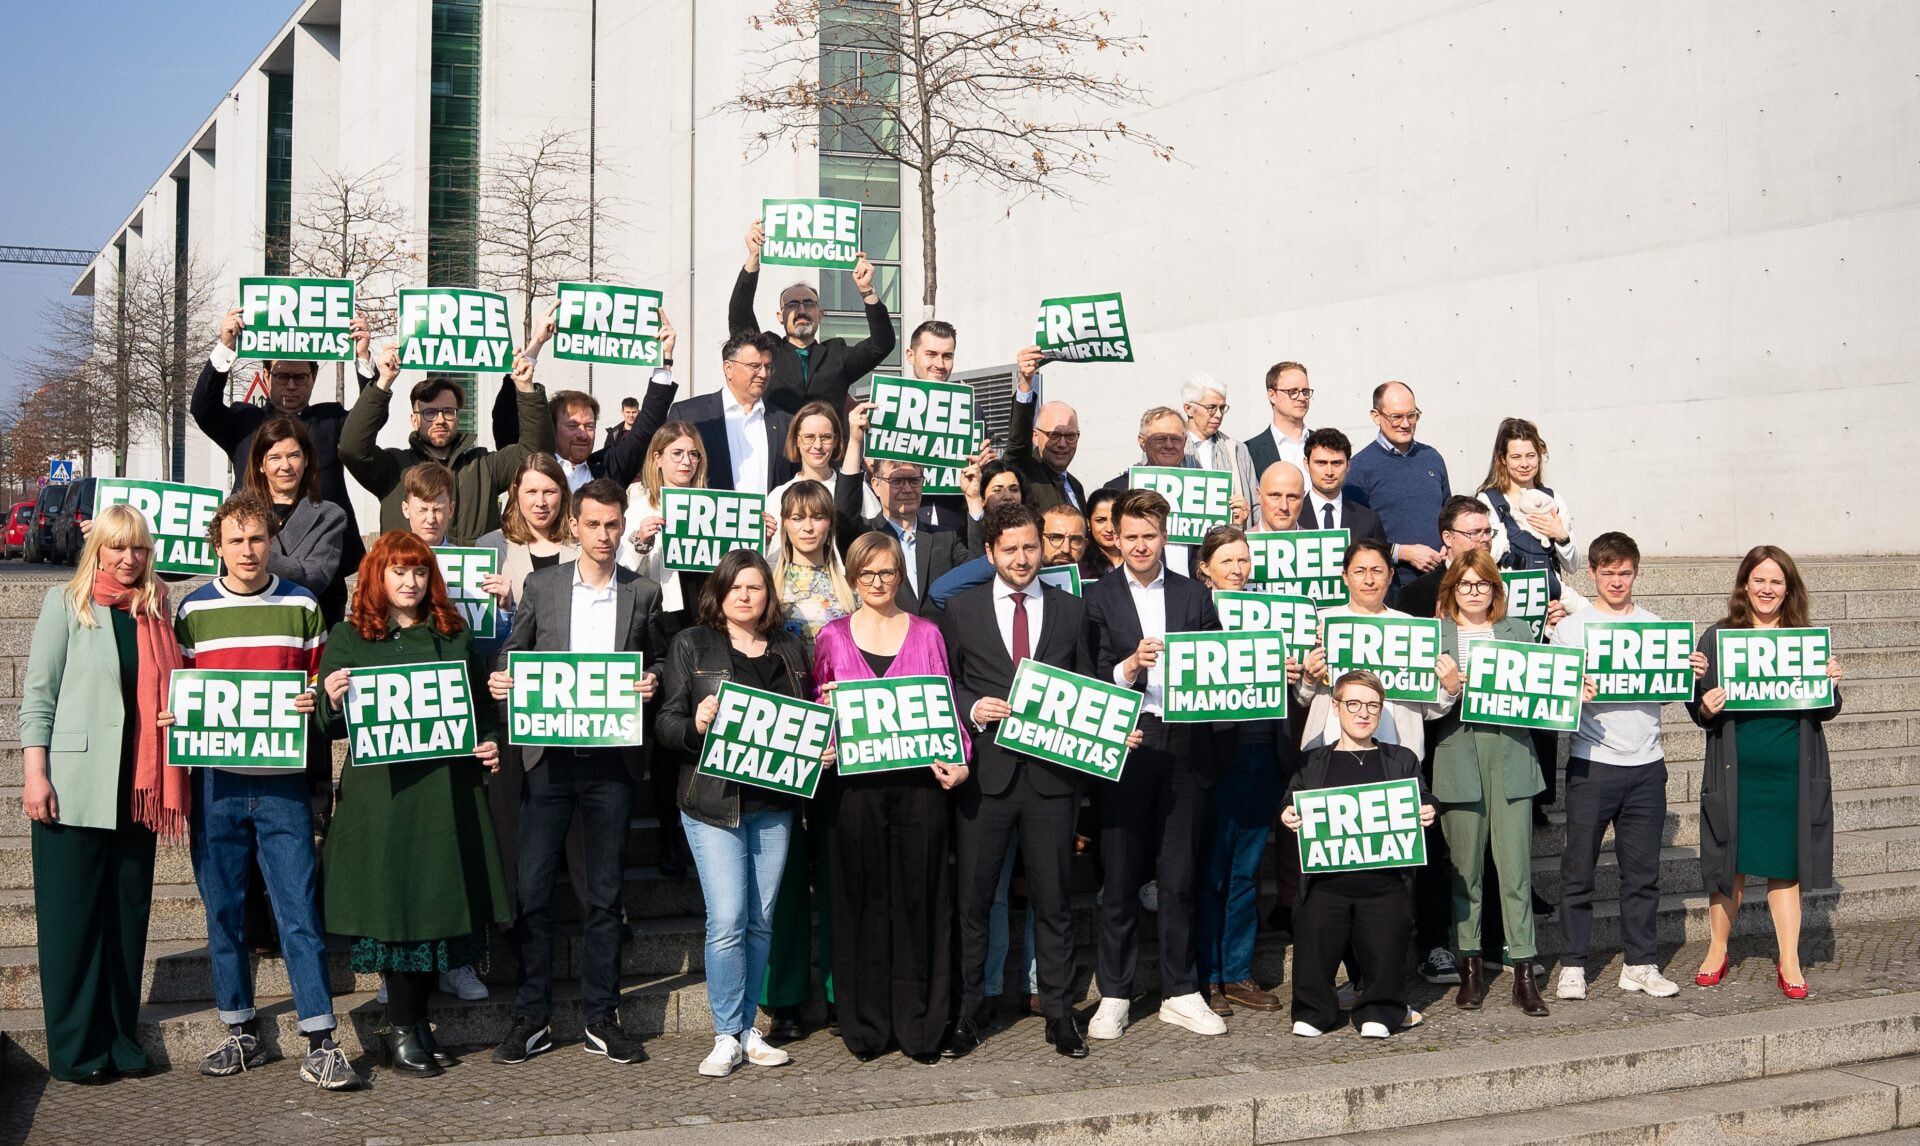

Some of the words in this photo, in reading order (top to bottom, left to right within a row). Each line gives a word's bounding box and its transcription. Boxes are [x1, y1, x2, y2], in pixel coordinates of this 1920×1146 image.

[765, 204, 856, 242] FREE
[764, 237, 857, 262] İMAMOĞLU
[243, 285, 350, 328] FREE
[403, 294, 509, 338] FREE
[559, 290, 659, 337] FREE
[1032, 299, 1124, 345] FREE
[242, 328, 350, 357] DEMİRTAŞ
[402, 338, 509, 367] ATALAY
[557, 332, 658, 363] DEMİRTAŞ
[1041, 340, 1128, 360] EMİRTAŞ
[871, 384, 970, 435] FREE
[868, 428, 928, 456] THEM
[928, 437, 968, 460] ALL
[665, 494, 761, 539] FREE
[168, 540, 214, 566] ALL
[1248, 537, 1345, 580] FREE
[436, 554, 490, 599] EE
[1308, 580, 1346, 600] ALL
[1169, 638, 1280, 686] FREE
[1328, 623, 1436, 668] FREE
[1587, 629, 1690, 670] FREE
[1722, 636, 1826, 678] FREE
[514, 662, 636, 708] FREE
[1469, 647, 1580, 697] FREE
[1649, 673, 1688, 694] ALL
[1724, 677, 1828, 700] İMAMOĞLU
[174, 680, 301, 728] FREE
[348, 669, 468, 724] FREE
[836, 684, 954, 737] FREE
[1012, 668, 1136, 744] FREE
[1169, 684, 1280, 712] İMAMOĞLU
[1468, 692, 1530, 718] THEM
[1532, 698, 1574, 722] ALL
[173, 731, 246, 757] THEM
[250, 732, 300, 758] ALL
[356, 718, 468, 758] ATALAY
[514, 709, 635, 740] DEMİRTAŞ
[711, 689, 830, 759] FREE
[1002, 717, 1120, 773] DEMİRTAŞ
[704, 738, 816, 789] ATALAY
[841, 732, 957, 766] DEMİRTAŞ
[1300, 786, 1417, 838] FREE
[1307, 832, 1417, 867] ATALAY
